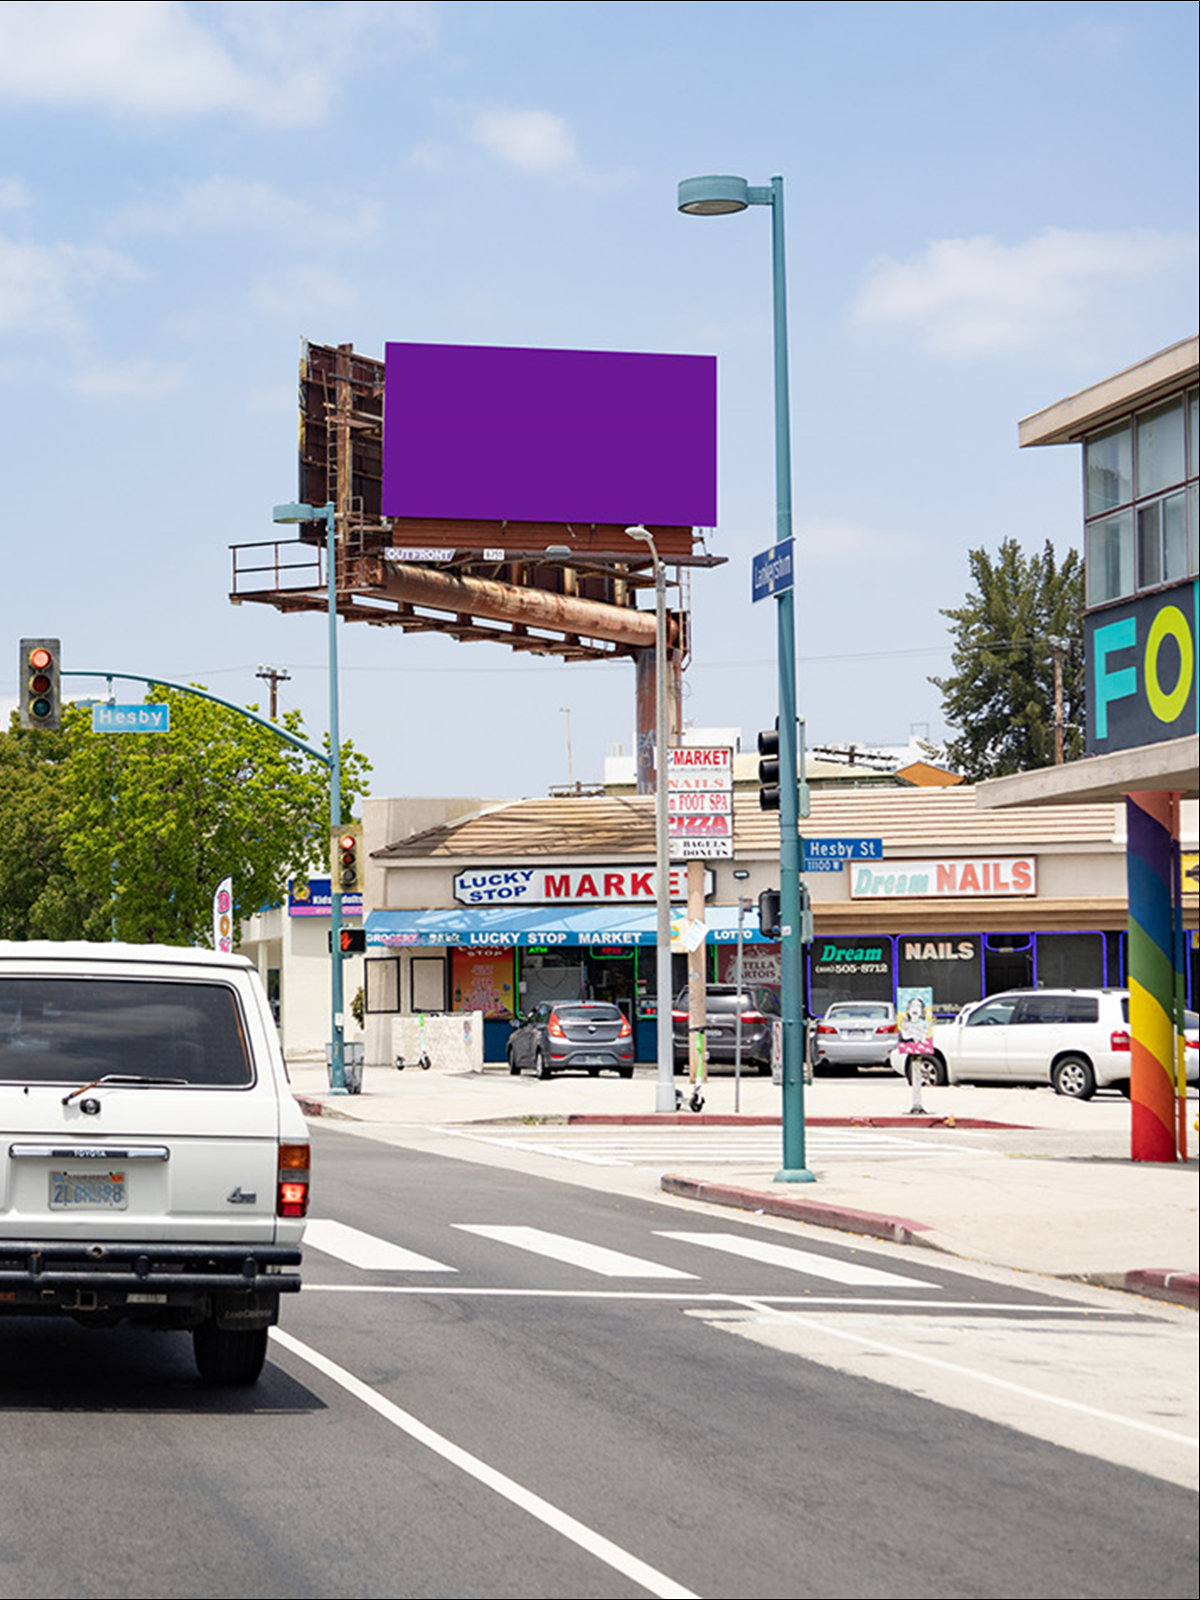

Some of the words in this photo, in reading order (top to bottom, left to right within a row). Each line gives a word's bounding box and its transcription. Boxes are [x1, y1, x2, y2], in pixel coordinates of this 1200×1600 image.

[1093, 580, 1199, 739] FO
[99, 709, 163, 727] Hesby
[673, 750, 729, 766] MARKET
[667, 779, 724, 789] NAILS
[679, 794, 705, 811] FOOT
[709, 794, 728, 811] SPA
[668, 816, 728, 829] PIZZA
[810, 841, 853, 858] Hesby
[860, 841, 875, 856] St
[459, 870, 534, 889] LUCKY
[544, 872, 706, 898] MARKE
[854, 868, 929, 895] Dream
[936, 861, 1032, 893] NAILS
[470, 885, 527, 902] STOP
[470, 933, 520, 944] LUCKY
[528, 933, 567, 944] STOP
[578, 932, 642, 944] MARKET
[820, 945, 883, 962] Dream
[905, 942, 974, 960] NAILS
[74, 1149, 107, 1158] TOYOTA
